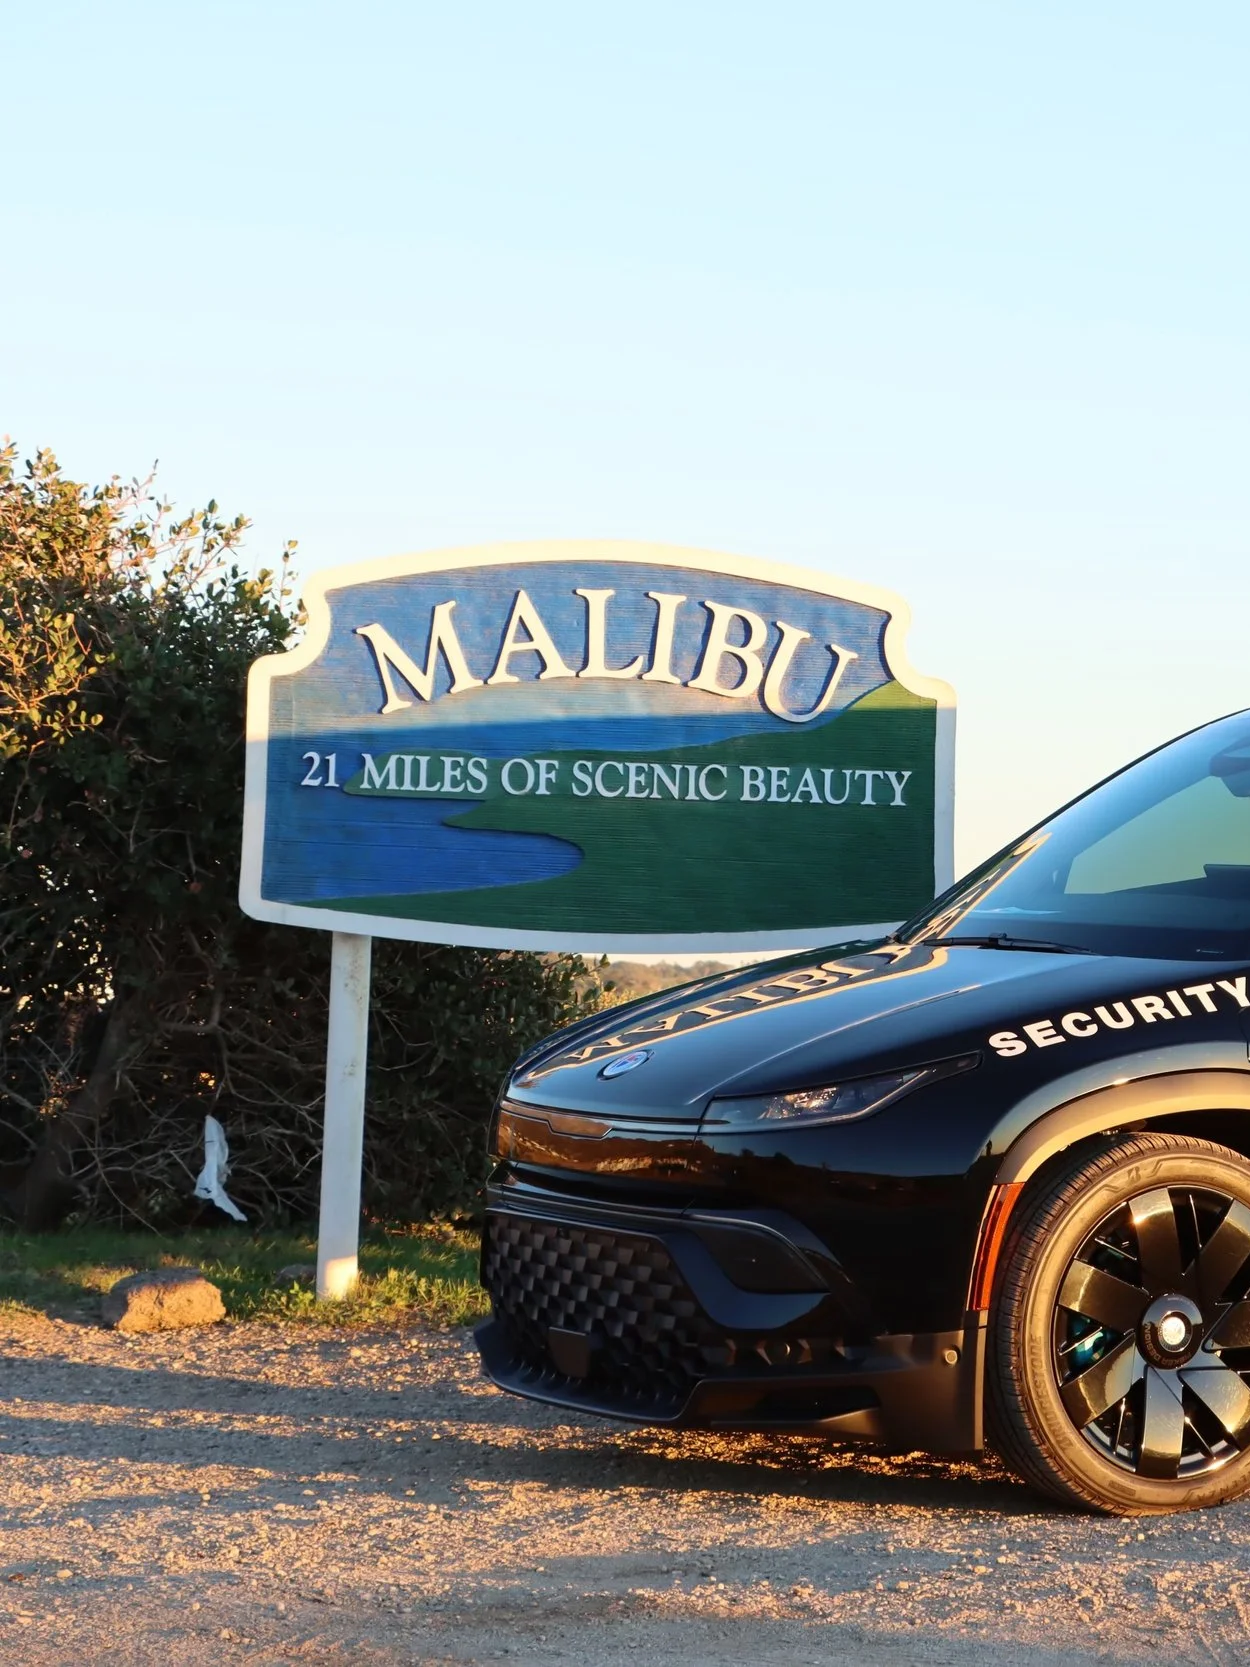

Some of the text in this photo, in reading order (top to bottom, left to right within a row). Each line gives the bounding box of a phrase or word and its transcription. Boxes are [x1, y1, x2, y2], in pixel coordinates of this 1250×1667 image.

[354, 588, 858, 723] MALIBU
[301, 752, 913, 807] 21 MILES OF SCENIC BEAUTY
[988, 976, 1250, 1057] SECURITY
